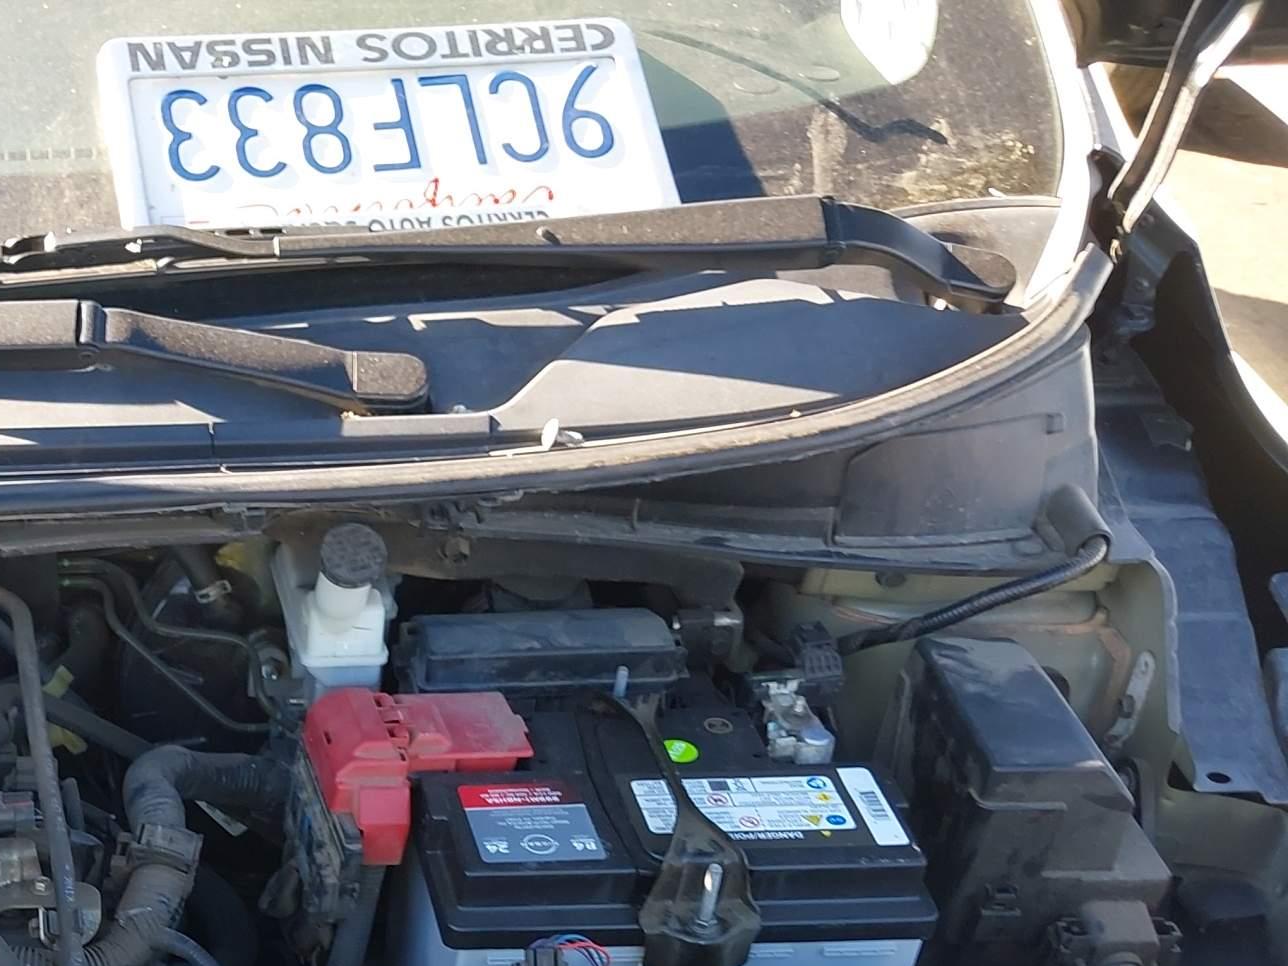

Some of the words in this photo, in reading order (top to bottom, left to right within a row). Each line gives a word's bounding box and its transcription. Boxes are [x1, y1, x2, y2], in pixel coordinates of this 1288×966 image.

[127, 36, 335, 72] NISSAN
[355, 23, 615, 63] CERRITOS
[161, 65, 615, 181] 9CLF833
